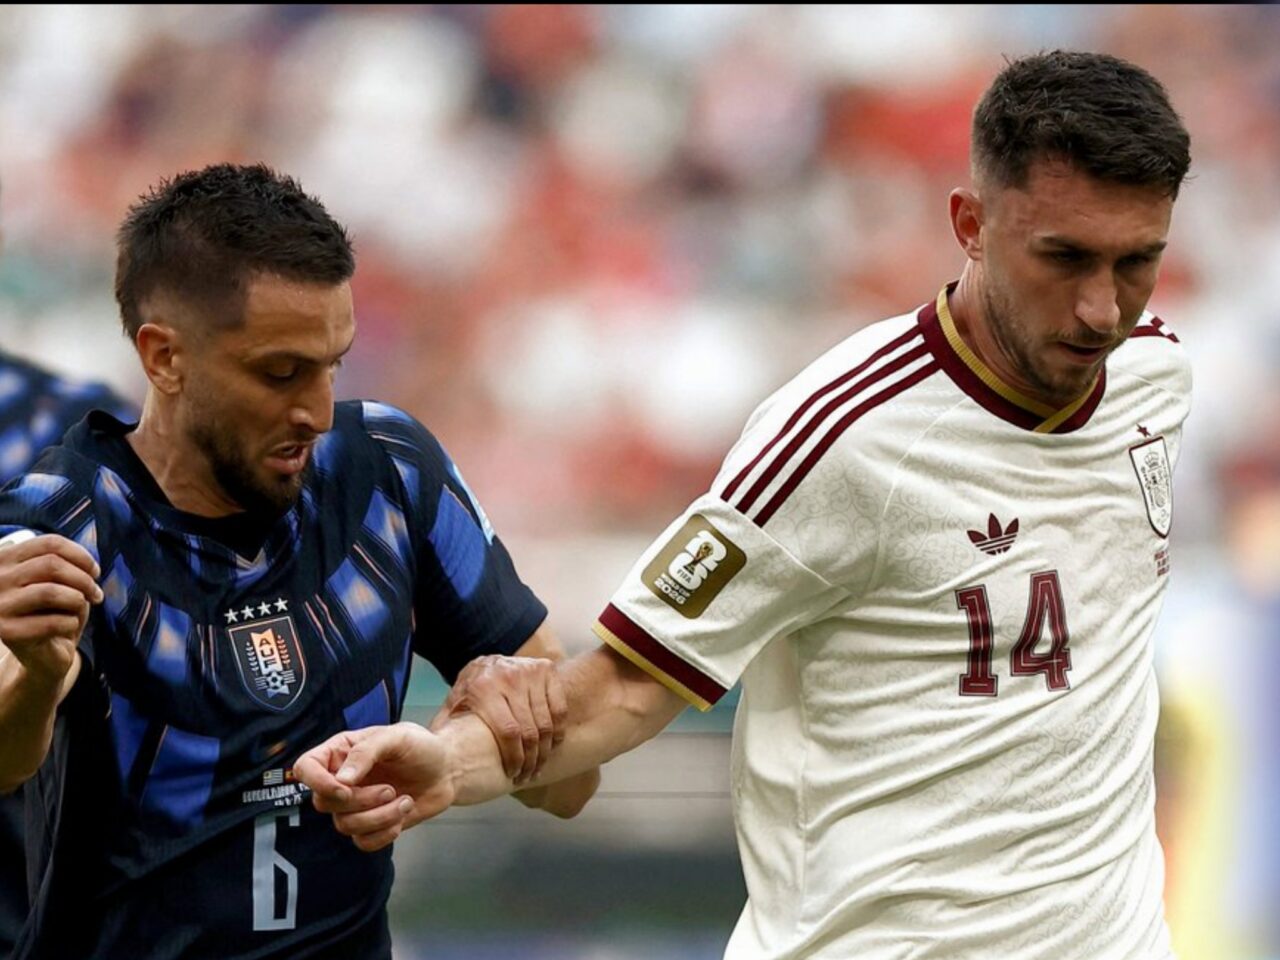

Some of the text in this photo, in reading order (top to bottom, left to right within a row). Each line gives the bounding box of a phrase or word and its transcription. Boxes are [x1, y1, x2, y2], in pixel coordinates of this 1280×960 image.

[653, 576, 687, 605] 2026
[676, 568, 693, 585] FIFA
[955, 569, 1072, 697] 14
[259, 637, 277, 669] AUF
[253, 806, 300, 931] 6
